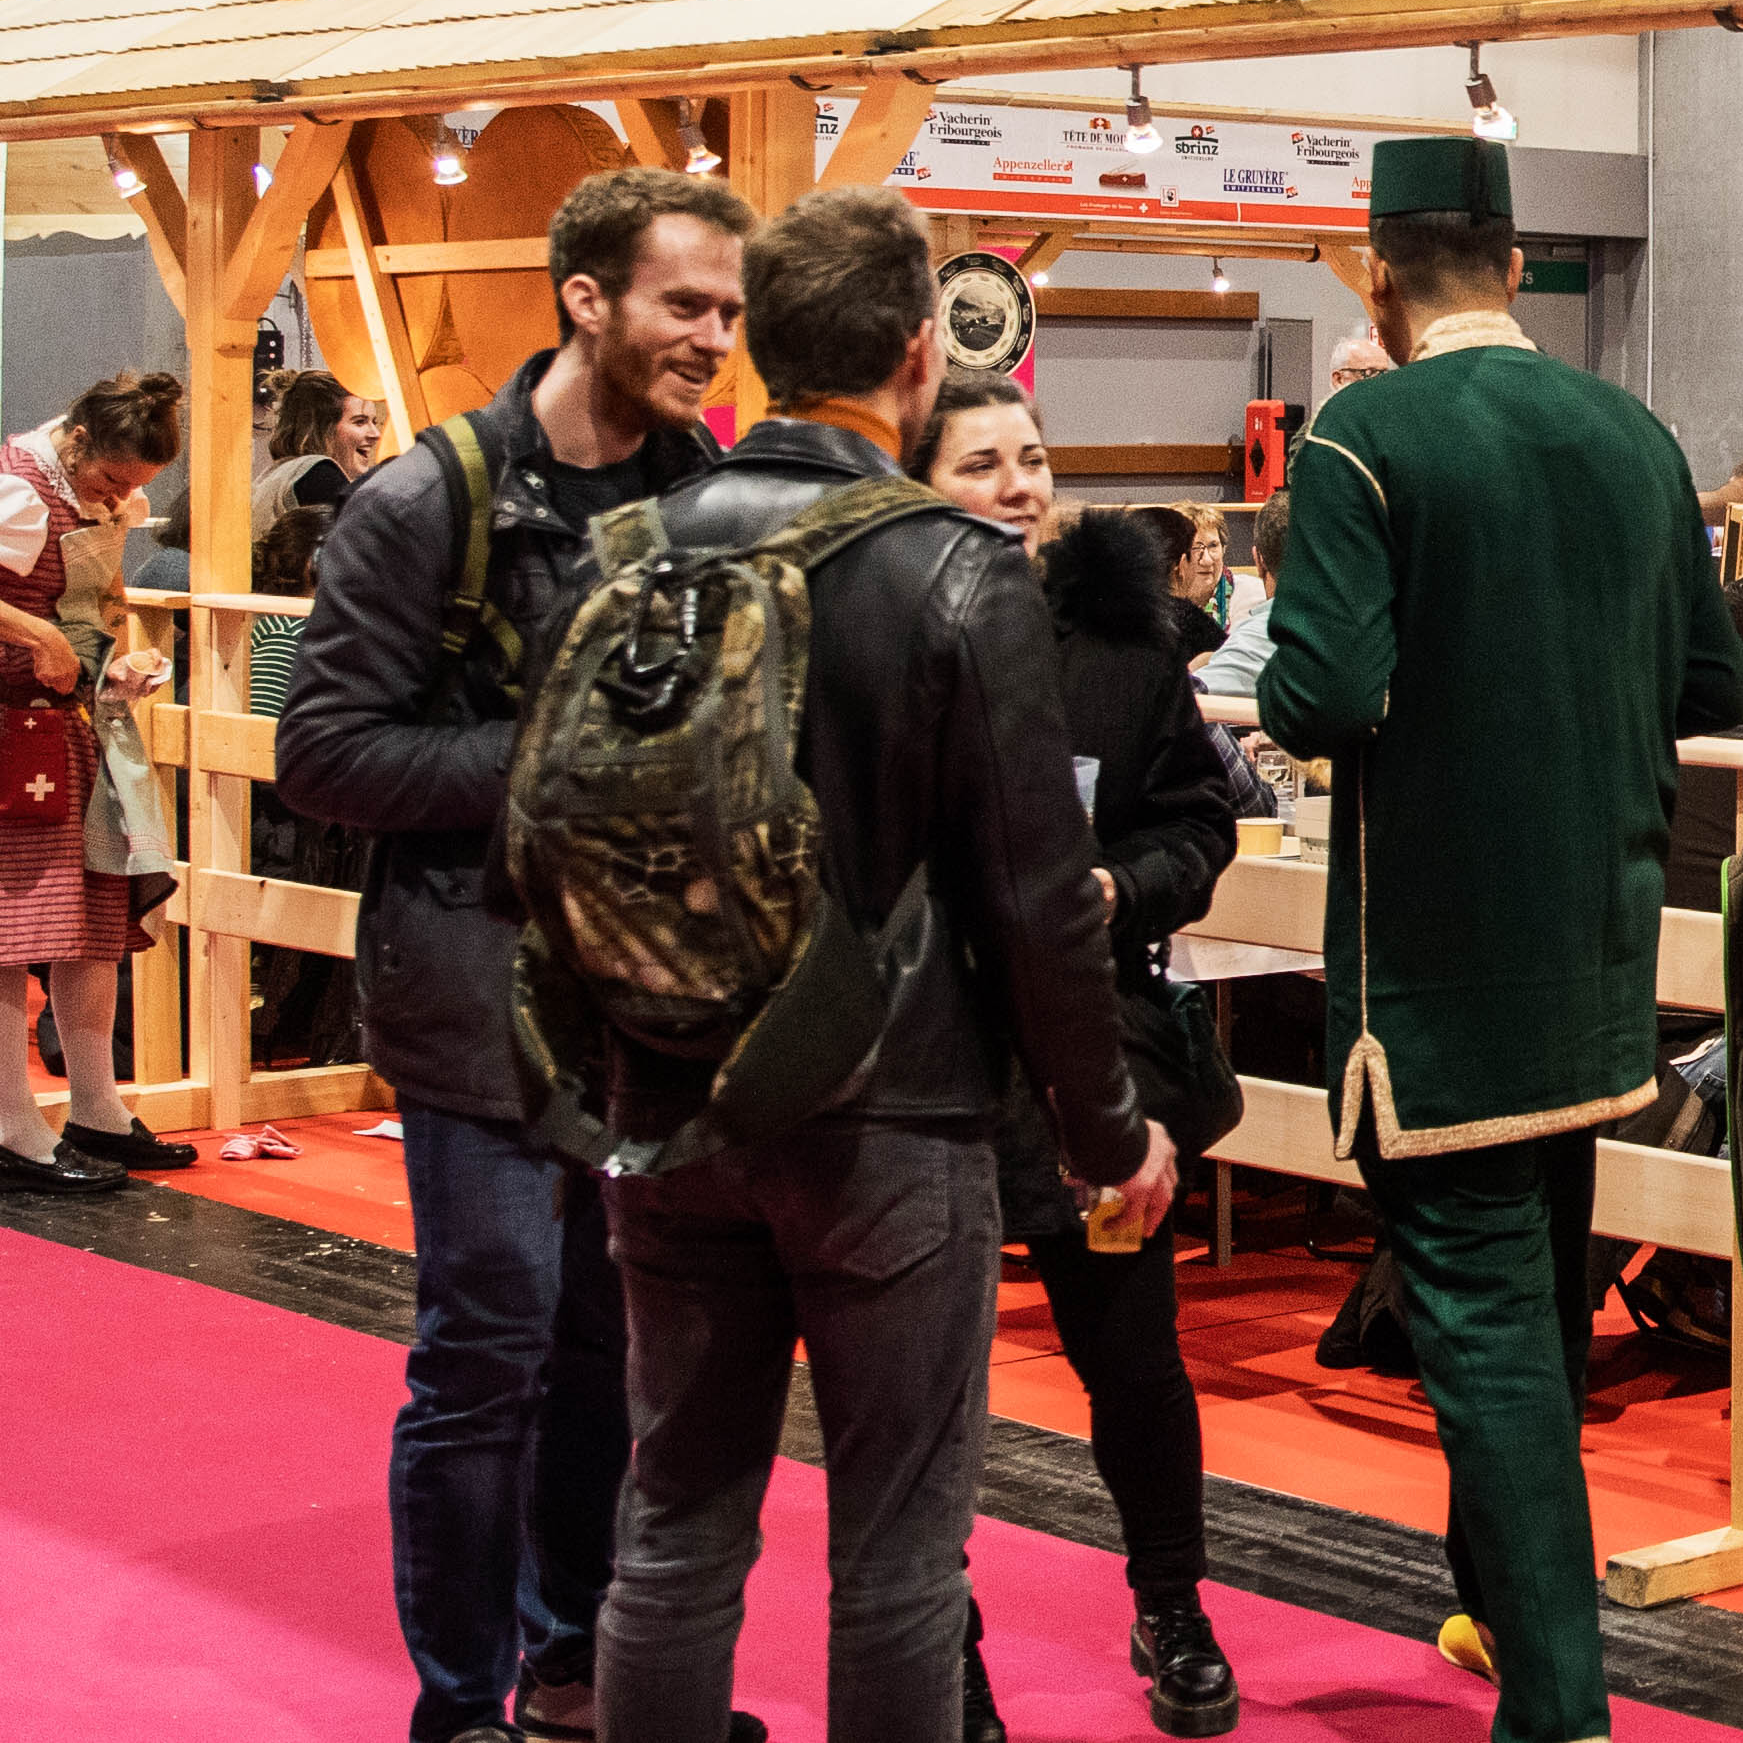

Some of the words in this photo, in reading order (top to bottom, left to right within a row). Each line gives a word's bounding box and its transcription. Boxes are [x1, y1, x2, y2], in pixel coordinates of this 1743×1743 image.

[939, 111, 990, 126] Vacherin
[929, 123, 1002, 139] Fribourgeois
[1063, 130, 1087, 143] TÊTE
[1090, 133, 1104, 143] DE
[1106, 133, 1127, 144] MOI
[1306, 134, 1350, 148] Vacherin
[1175, 141, 1219, 156] sbrinz
[1297, 145, 1360, 159] Fribourgeois
[993, 157, 1063, 171] Appenzeller
[1224, 169, 1235, 183] LE
[1238, 168, 1285, 185] GRUYÈRE
